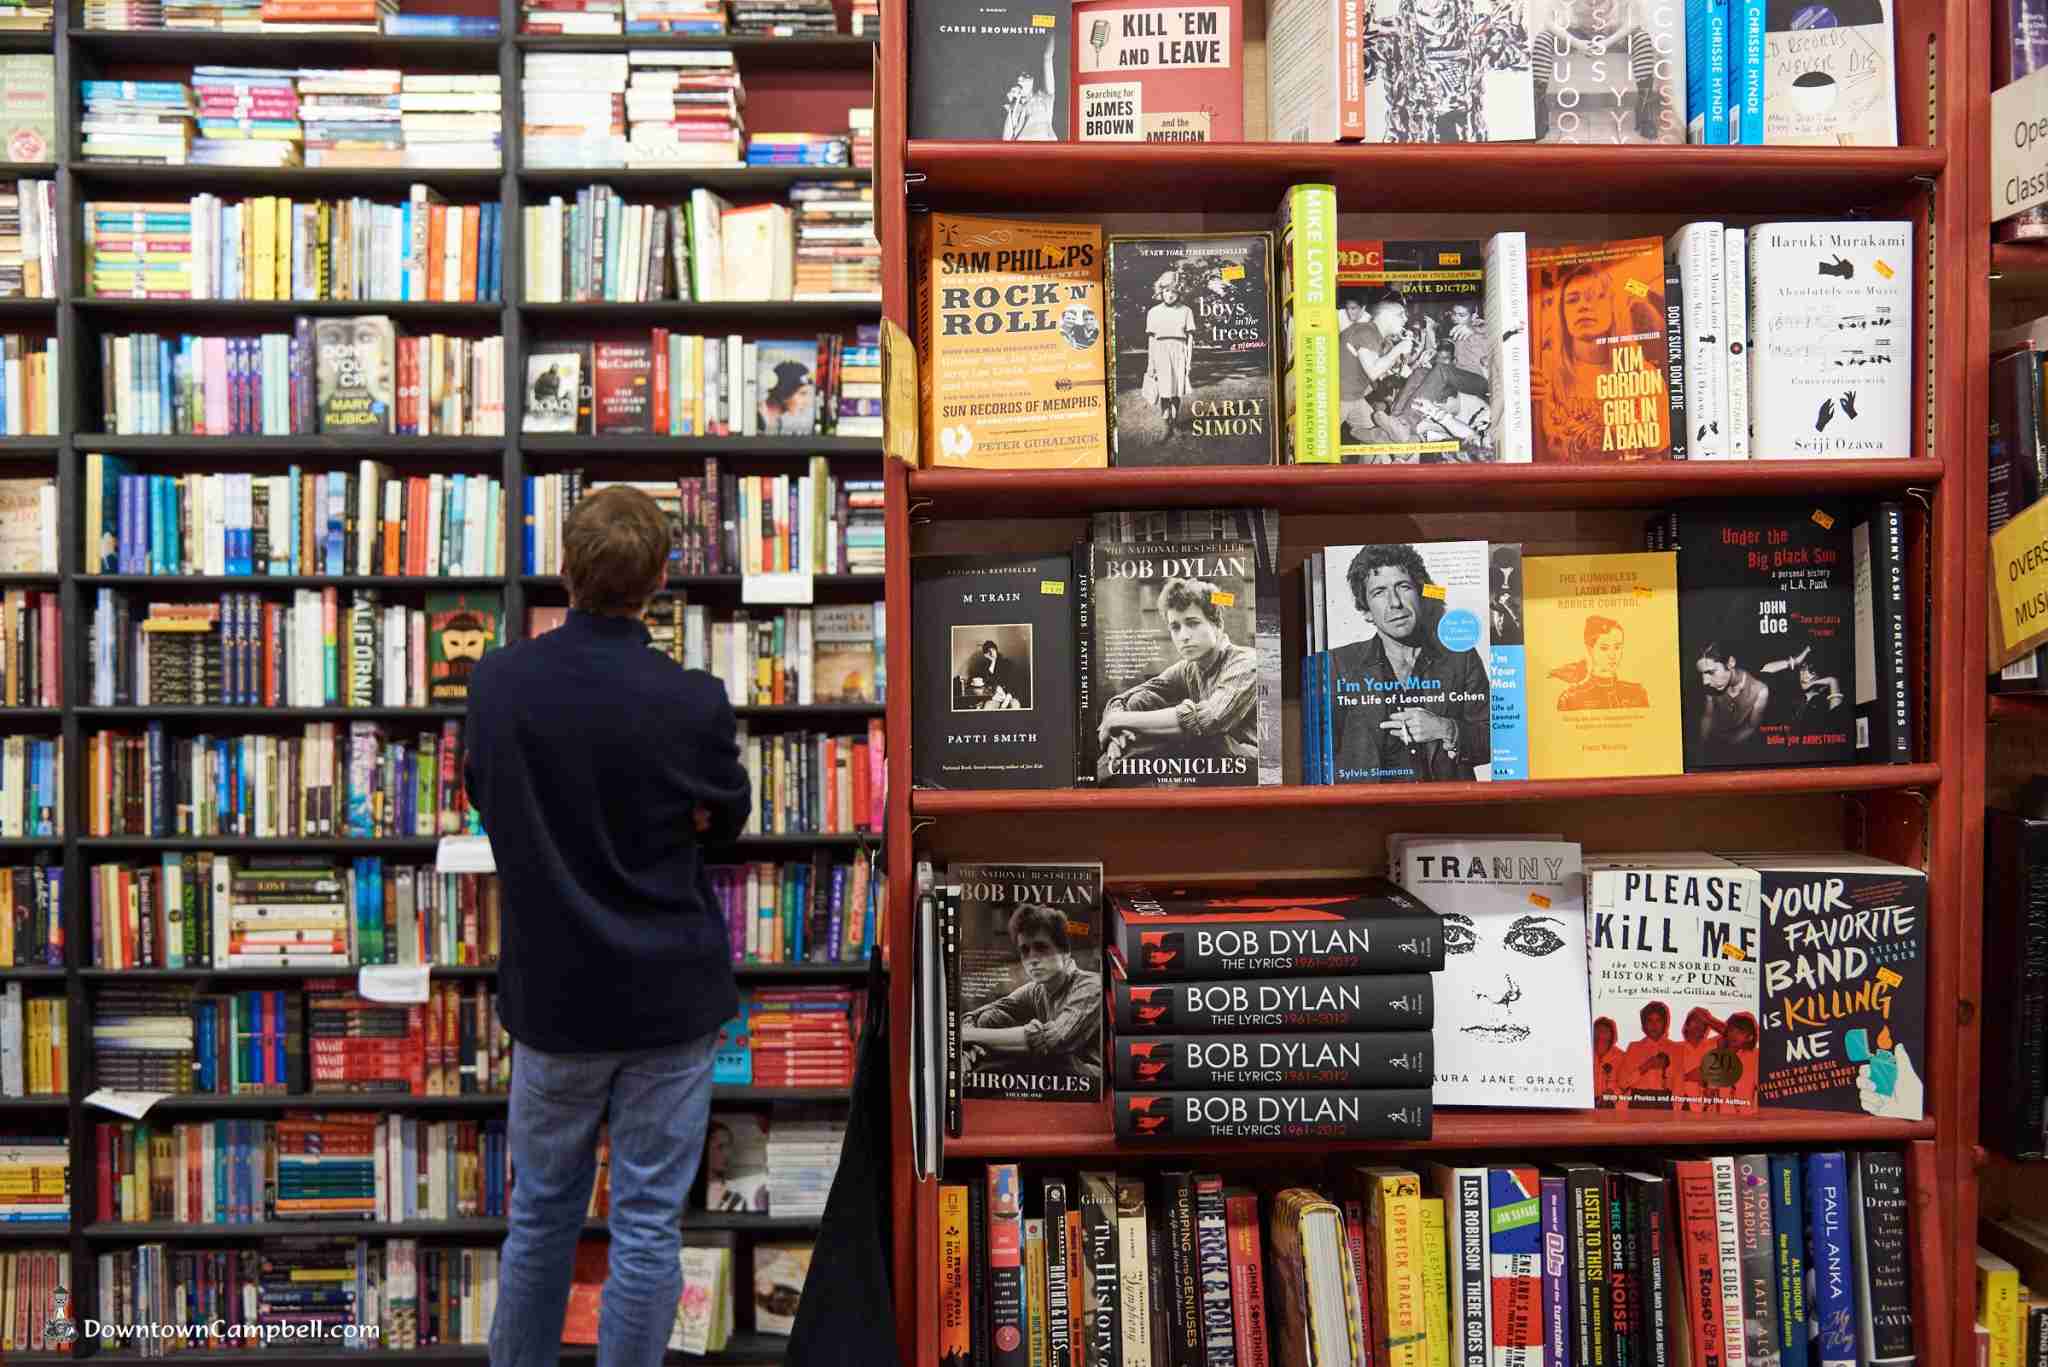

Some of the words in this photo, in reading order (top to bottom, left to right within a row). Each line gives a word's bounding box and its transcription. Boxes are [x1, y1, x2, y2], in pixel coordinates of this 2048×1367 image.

[940, 25, 976, 34] CARRIE
[981, 25, 1046, 35] BROWNSTEIN
[1123, 14, 1167, 37] KILL
[1179, 12, 1217, 35] 'EM
[1748, 7, 1760, 68] CHRISSIE
[1120, 47, 1149, 66] AND
[1159, 40, 1220, 65] LEAVE
[1086, 87, 1119, 100] Searching
[1122, 87, 1135, 99] for
[1747, 70, 1759, 115] HYNDE
[1086, 100, 1133, 117] JAMES
[1086, 118, 1134, 136] BROWN
[1162, 118, 1174, 128] and
[1176, 117, 1189, 128] the
[2015, 118, 2048, 152] Ope
[1146, 130, 1204, 143] AMERICAN
[1305, 190, 1322, 241] MIKE
[1771, 235, 1823, 248] Haruki
[1830, 234, 1906, 248] Murakami
[942, 251, 991, 274] SAM
[997, 244, 1094, 272] PHILLIPS
[1307, 250, 1324, 304] LOVE
[1402, 284, 1432, 294] DAVE
[1436, 283, 1476, 292] DICTOR
[942, 283, 1060, 309] ROCK
[1777, 287, 1841, 297] Absolutely
[1847, 288, 1860, 296] on
[1866, 287, 1898, 296] Music
[1200, 296, 1247, 317] boys
[942, 310, 1056, 335] ROLL
[1235, 317, 1243, 325] in
[1243, 316, 1258, 325] the
[1668, 306, 1681, 333] DON'T
[1213, 326, 1259, 341] trees
[1612, 346, 1643, 372] KIM
[1669, 336, 1682, 363] SUCK,
[1596, 370, 1663, 399] GORDON
[1670, 365, 1683, 393] DON'T
[1791, 376, 1860, 385] Conversations
[1865, 377, 1886, 385] with
[943, 405, 966, 418] SUN
[970, 401, 1022, 416] RECORDS
[1026, 400, 1038, 413] OF
[1191, 399, 1264, 417] CARLY
[1603, 400, 1638, 426] GIRL
[1641, 398, 1657, 423] IN
[1672, 395, 1684, 410] DIE
[1192, 418, 1264, 436] SIMON
[1603, 429, 1613, 451] A
[1616, 424, 1660, 450] BAND
[978, 441, 1021, 451] PETER
[1024, 434, 1099, 449] GURALNICK
[1794, 439, 1830, 454] Seiji
[1836, 439, 1883, 450] Ozawa
[1128, 544, 1178, 553] NATIONAL
[1181, 543, 1245, 552] BESTSELLER
[1722, 528, 1760, 545] Under
[1767, 527, 1789, 544] the
[1889, 511, 1899, 561] JOHNNY
[1106, 560, 1155, 579] BOB
[1162, 557, 1246, 578] DYLAN
[1748, 552, 1769, 570] Big
[1774, 548, 1809, 566] Black
[1813, 548, 1836, 563] Sun
[2010, 540, 2048, 581] OVERS
[1078, 574, 1087, 599] JUST
[1891, 567, 1900, 601] CASH
[963, 594, 973, 603] M
[979, 592, 1021, 602] TRAIN
[1759, 601, 1786, 614] JOHN
[2016, 592, 2048, 626] MUSI
[1080, 603, 1088, 628] KIDS
[1760, 616, 1788, 634] doe
[1080, 640, 1088, 670] PATTI
[1894, 615, 1904, 674] FOREVER
[1081, 675, 1089, 710] SMITH
[1336, 679, 1360, 693] I'm
[1363, 678, 1401, 692] Your
[1406, 677, 1441, 690] Man
[1337, 696, 1357, 706] The
[1361, 694, 1381, 705] Life
[1385, 694, 1397, 704] of
[1400, 693, 1444, 704] Leonard
[1449, 692, 1485, 702] Cohen
[1896, 680, 1905, 726] WORDS
[948, 734, 987, 744] PATTI
[993, 733, 1038, 743] SMITH
[1108, 758, 1247, 777] CHRONICLES
[1338, 769, 1369, 778] Sylvie
[1371, 767, 1414, 777] Simmons
[1417, 856, 1564, 880] TRANNY
[960, 882, 1005, 902] BOB
[1012, 884, 1094, 905] DYLAN
[1625, 873, 1742, 912] PLEASE
[1761, 878, 1852, 926] YOUR
[1783, 905, 1916, 951] FAVORITE
[1198, 930, 1259, 956] BOB
[1270, 928, 1370, 954] DYLAN
[1702, 920, 1757, 963] ME
[1870, 939, 1917, 954] STEVEN
[1221, 959, 1246, 969] THE
[1249, 958, 1293, 969] LYRICS
[1633, 961, 1721, 971] UNCENSORED
[1876, 951, 1916, 964] HYDEN
[1602, 970, 1664, 981] HISTORY
[1687, 972, 1736, 987] PUNK
[1765, 946, 1868, 999] BAND
[1187, 987, 1249, 1012] BOB
[1259, 985, 1360, 1011] DYLAN
[1763, 1011, 1783, 1030] IS
[1784, 980, 1892, 1030] KILLING
[1211, 1015, 1236, 1025] THE
[1239, 1014, 1283, 1026] LYRICS
[1187, 1044, 1249, 1069] BOB
[1260, 1042, 1360, 1068] DYLAN
[1786, 1030, 1832, 1062] ME
[960, 1072, 1090, 1092] CHRONICLES
[1480, 1074, 1514, 1084] JANE
[1526, 1076, 1573, 1085] GRACE
[1186, 1098, 1248, 1123] BOB
[1259, 1097, 1359, 1122] DYLAN
[1869, 1163, 1902, 1178] Deep
[1464, 1180, 1479, 1207] LISA
[1716, 1164, 1734, 1214] COMEDY
[1874, 1180, 1887, 1191] in
[1178, 1188, 1192, 1251] BUMPING
[1584, 1187, 1600, 1228] LISTEN
[1824, 1186, 1839, 1237] PAUL
[1883, 1214, 1900, 1222] The
[1095, 1221, 1110, 1256] The
[1393, 1205, 1408, 1268] LIPSTICK
[1586, 1232, 1602, 1246] TO
[1719, 1220, 1731, 1233] AT
[1879, 1227, 1903, 1236] Long
[1465, 1209, 1481, 1270] ROBINSON
[1612, 1234, 1623, 1270] SOME
[1874, 1239, 1901, 1249] Night
[1721, 1241, 1735, 1264] THE
[1586, 1251, 1603, 1281] THIS!
[1828, 1243, 1842, 1299] ANKA
[1877, 1265, 1901, 1273] Chet
[1723, 1269, 1738, 1299] EDGE
[1875, 1279, 1904, 1288] Baker
[1096, 1264, 1116, 1351] History
[1184, 1277, 1197, 1347] GENIUSES
[1399, 1276, 1412, 1327] TRACES
[1467, 1281, 1481, 1318] THERE
[1612, 1274, 1627, 1335] NOISE
[1754, 1279, 1768, 1320] KATE
[1468, 1322, 1483, 1353] GOES
[1725, 1305, 1742, 1361] RICHARD
